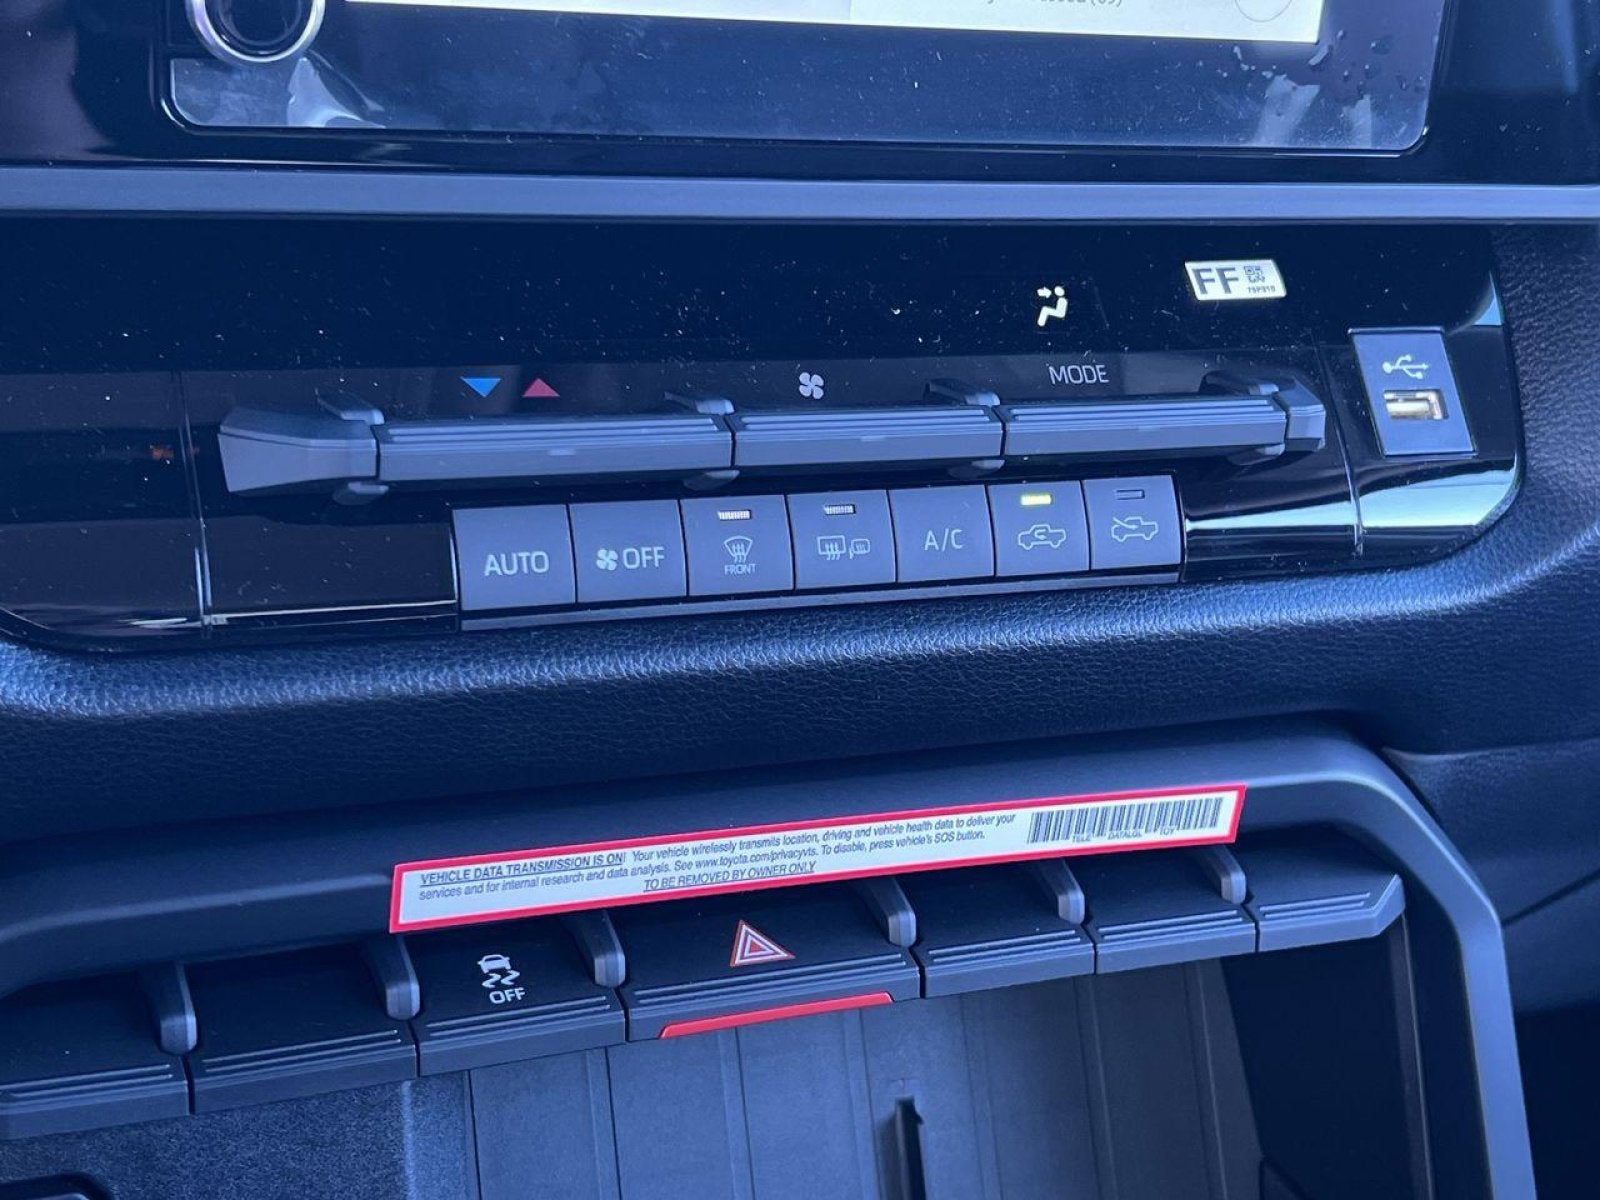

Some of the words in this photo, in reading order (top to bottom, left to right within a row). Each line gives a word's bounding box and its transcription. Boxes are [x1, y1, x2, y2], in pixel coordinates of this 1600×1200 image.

[1191, 267, 1239, 294] FF
[1049, 364, 1110, 385] MODE
[924, 527, 963, 551] A/C
[484, 550, 550, 577] AUTO
[622, 546, 665, 570] OFF
[724, 563, 757, 576] FRONT
[420, 868, 470, 886] VEHICLE
[473, 864, 503, 880] DATA
[506, 857, 590, 876] TRANSMISSION
[593, 854, 604, 866] IS
[633, 849, 654, 862] Your
[657, 845, 689, 860] vehicle
[692, 842, 737, 854] wirelessly
[739, 836, 780, 850] transmits
[782, 833, 820, 845] location,
[822, 828, 852, 844] driving
[854, 827, 871, 839] and
[873, 823, 905, 837] vehicle
[905, 820, 932, 834] health
[934, 817, 954, 830] data
[955, 816, 964, 828] to
[966, 813, 995, 828] deliver
[996, 813, 1016, 828] your
[419, 885, 462, 901] services
[464, 882, 484, 895] and
[486, 880, 500, 893] for
[502, 875, 539, 891] internal
[541, 870, 585, 887] research
[587, 867, 606, 880] and
[607, 864, 629, 878] data
[630, 861, 672, 877] analysis.
[674, 858, 693, 872] See
[821, 844, 832, 856] To
[833, 840, 867, 855] disable,
[869, 838, 894, 853] press
[895, 833, 933, 848] vehicle's
[934, 830, 955, 844] SOS
[956, 829, 986, 843] button.
[643, 878, 660, 892] TO
[661, 875, 677, 889] BE
[678, 870, 731, 887] REMOVED
[731, 868, 745, 881] BY
[747, 864, 786, 880] OWNER
[788, 860, 817, 874] ONLY
[489, 986, 526, 1004] OFF
